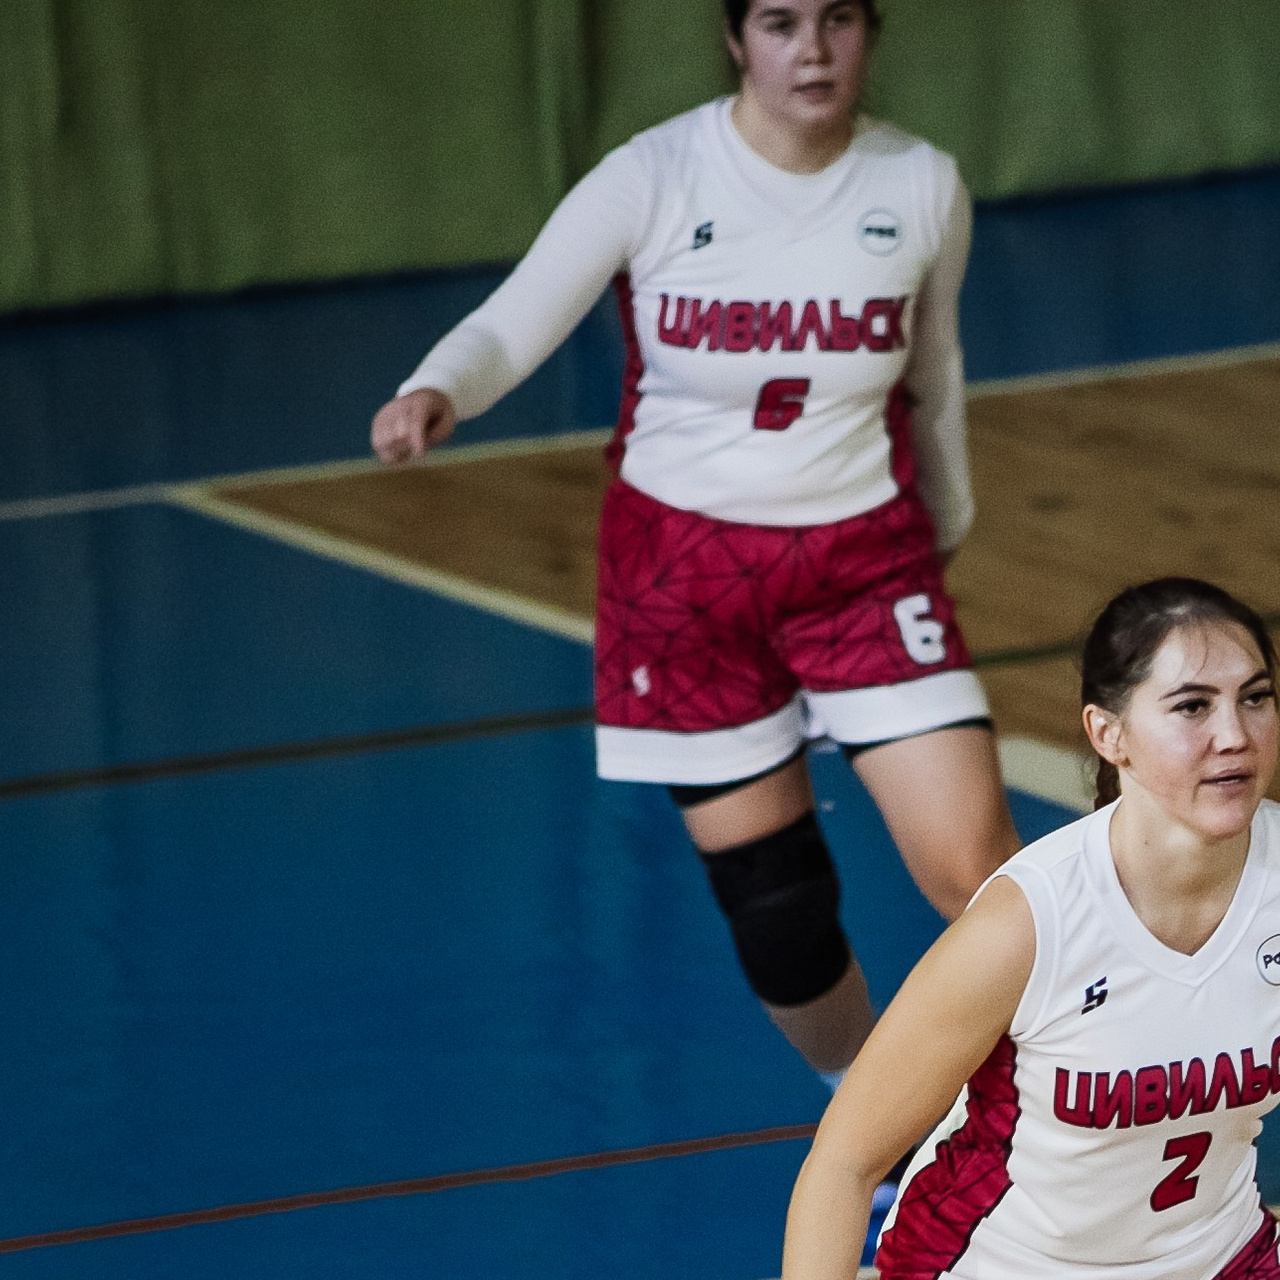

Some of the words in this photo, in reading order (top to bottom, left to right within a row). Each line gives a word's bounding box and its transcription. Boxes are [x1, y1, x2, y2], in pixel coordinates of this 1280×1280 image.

[754, 378, 810, 431] 6
[893, 594, 946, 665] 6
[1150, 1131, 1213, 1212] 2
